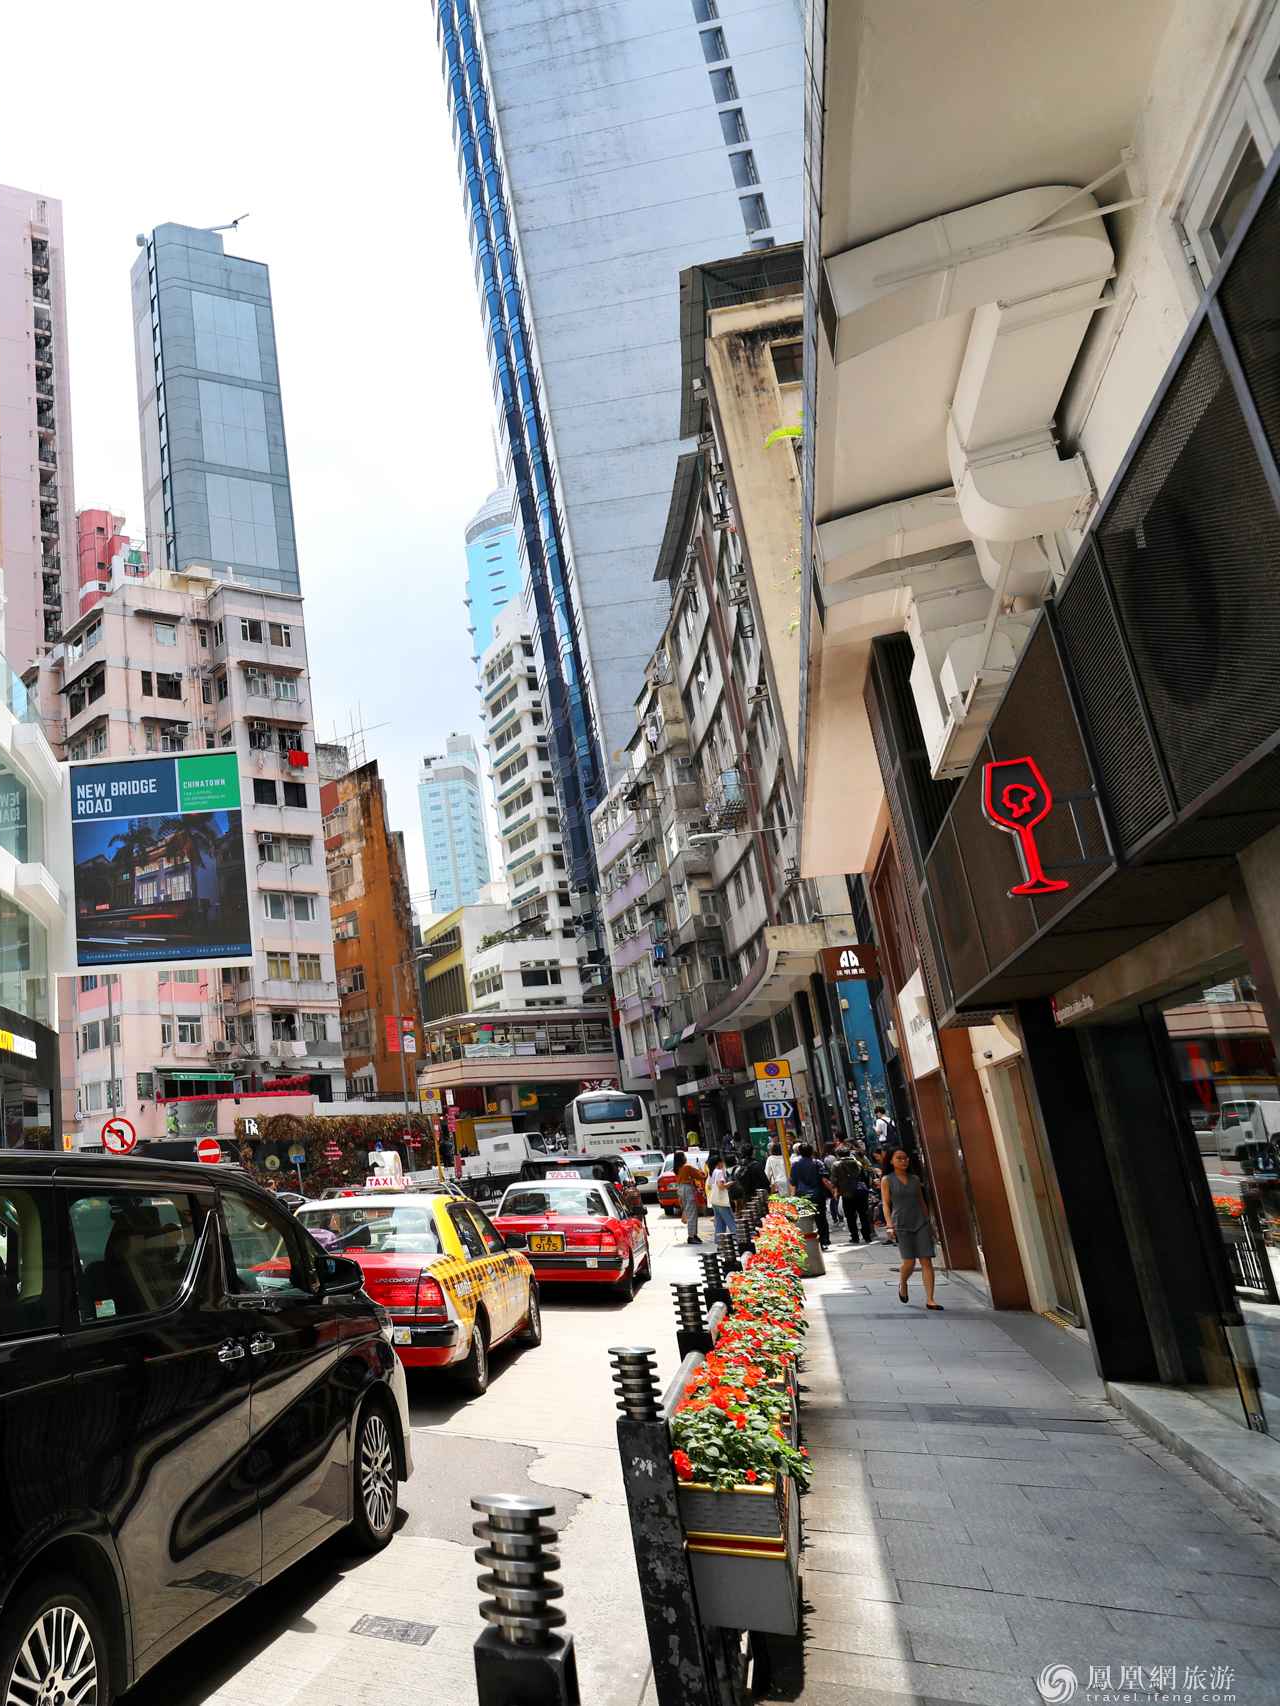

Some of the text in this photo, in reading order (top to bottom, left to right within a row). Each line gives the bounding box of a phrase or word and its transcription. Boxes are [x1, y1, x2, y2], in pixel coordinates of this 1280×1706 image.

[77, 778, 158, 799] NEW BRIDGE
[182, 778, 226, 789] CHINATOWN
[77, 798, 113, 815] ROAD
[781, 1090, 788, 1098] 7
[487, 1102, 498, 1113] SUB
[768, 1104, 779, 1116] P
[368, 1177, 393, 1186] TAXI
[540, 1236, 553, 1245] FA
[535, 1243, 559, 1251] 9175
